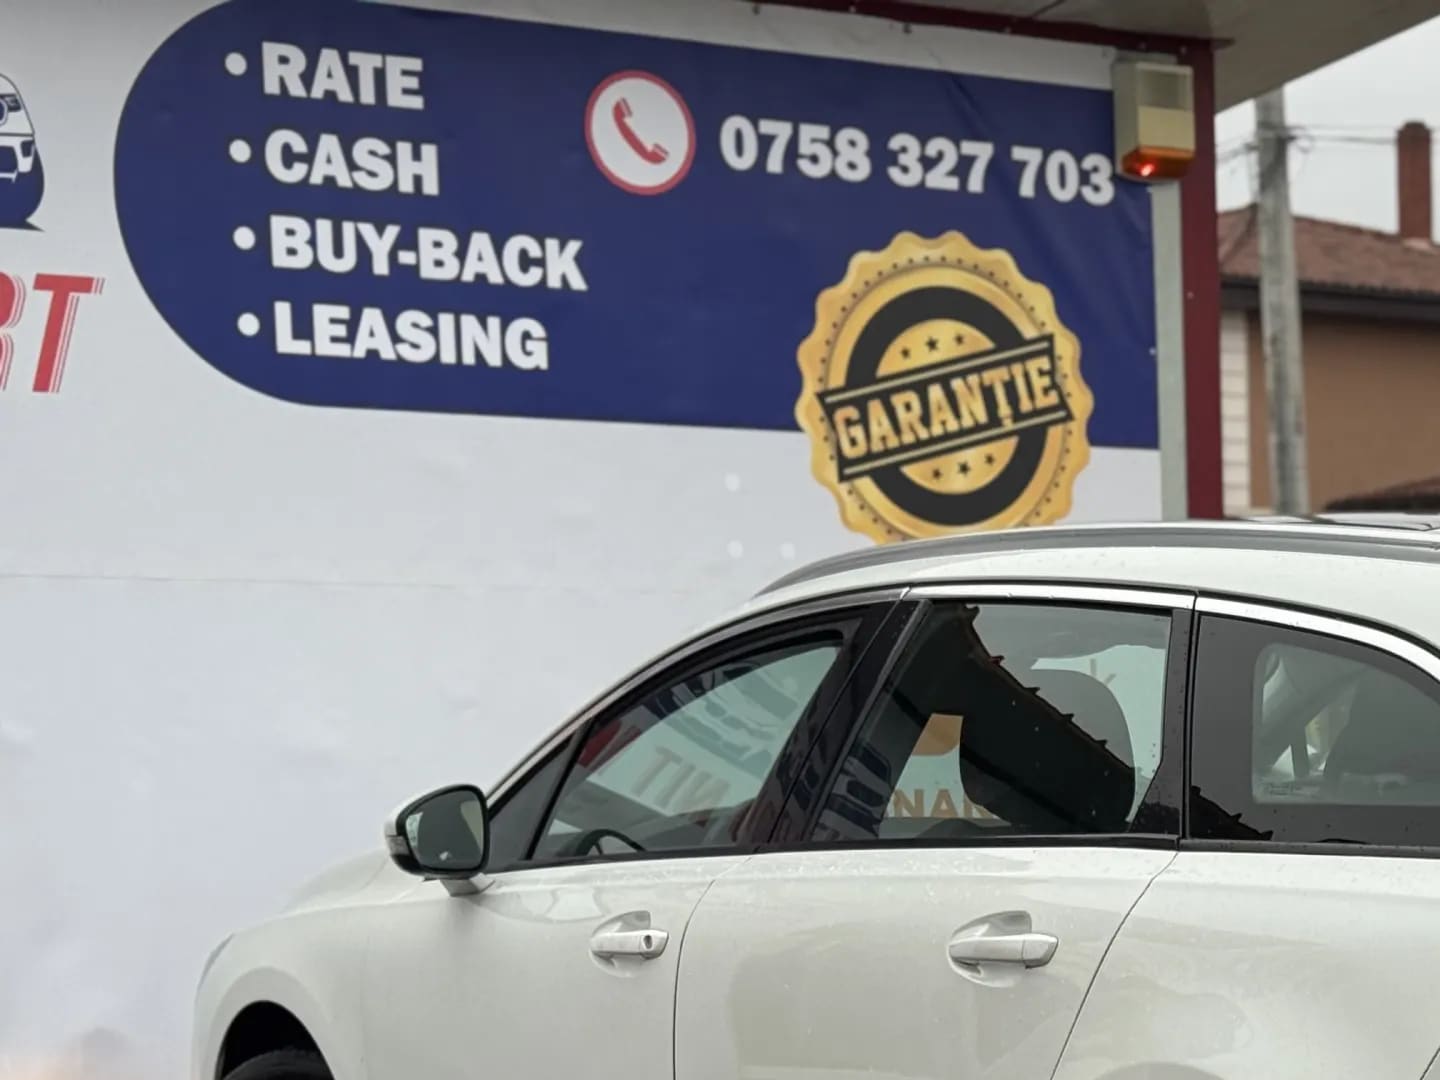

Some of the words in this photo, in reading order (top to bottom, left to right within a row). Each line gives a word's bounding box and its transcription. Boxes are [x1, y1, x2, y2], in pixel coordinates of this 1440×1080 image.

[261, 41, 424, 109] RATE
[264, 129, 439, 195] CASH
[719, 115, 871, 183] 0758
[887, 134, 994, 194] 327
[1010, 146, 1116, 206] 703
[269, 214, 588, 291] BUY-BACK
[0, 271, 105, 393] T
[273, 301, 549, 370] LEASING
